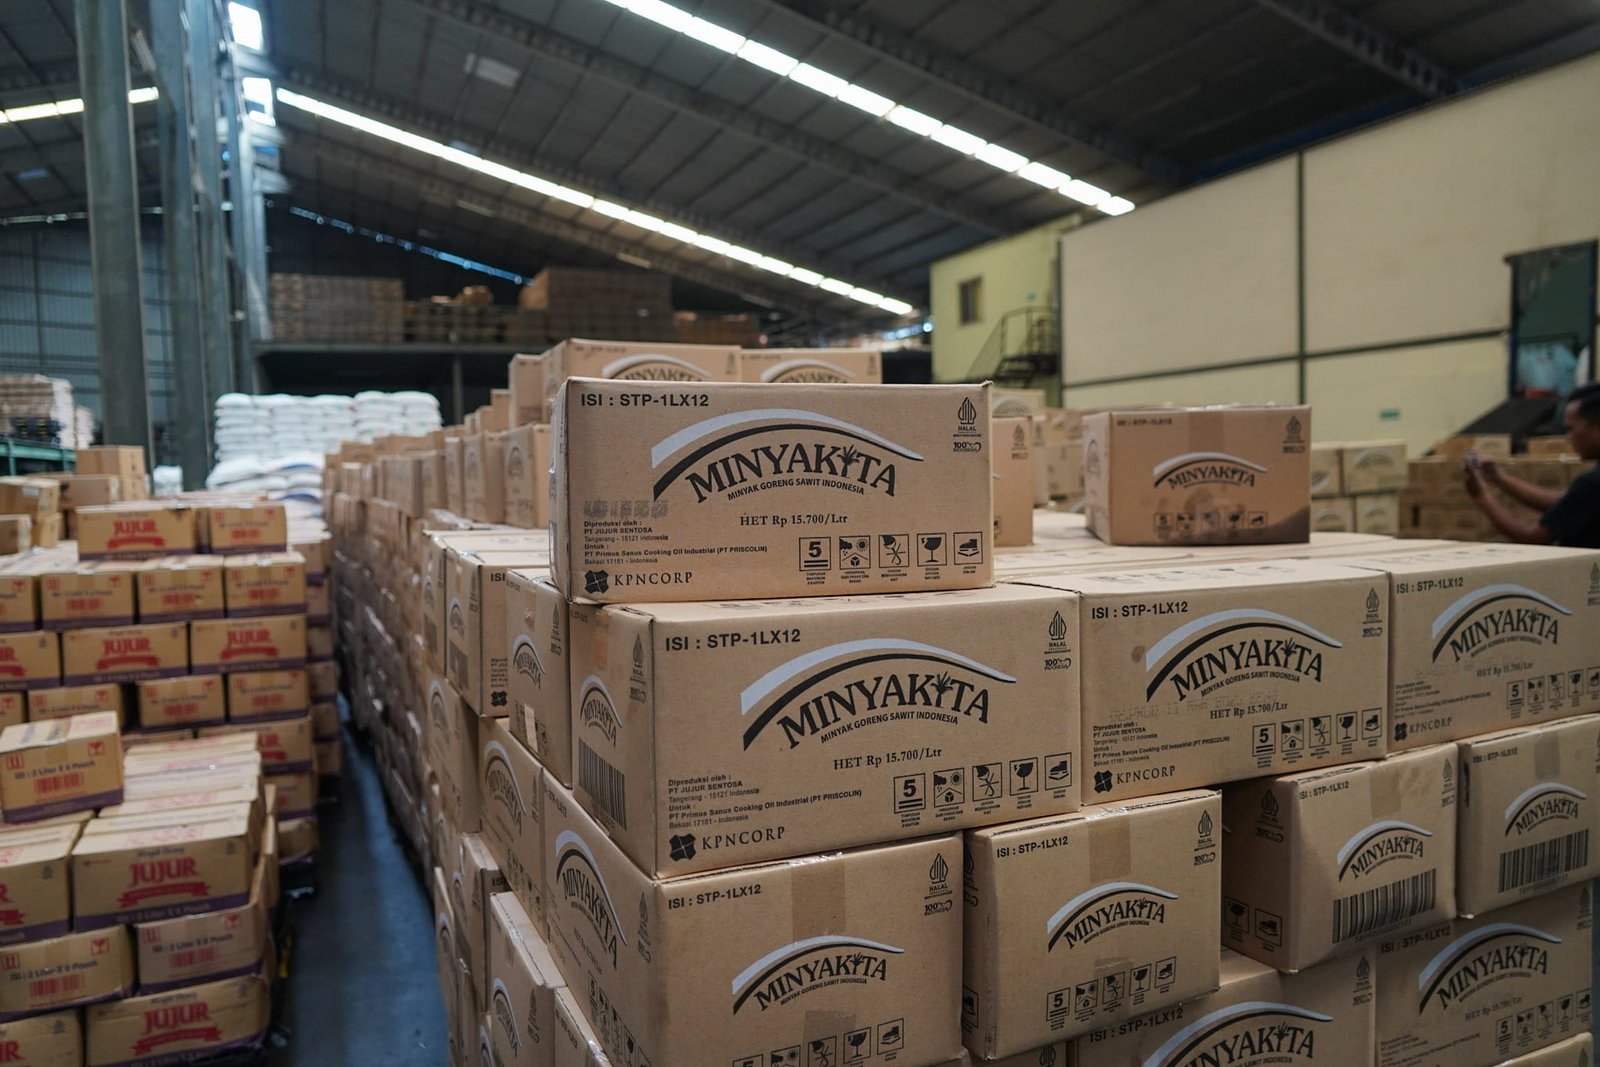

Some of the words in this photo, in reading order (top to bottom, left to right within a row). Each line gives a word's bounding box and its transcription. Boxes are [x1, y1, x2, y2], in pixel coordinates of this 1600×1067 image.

[581, 394, 603, 406] ISI
[620, 394, 709, 406] STP-1LX12
[685, 443, 895, 503] MINYAKITA
[1168, 466, 1256, 489] MINYAKITA
[728, 484, 759, 501] MINYAK
[760, 478, 794, 490] GORENG
[796, 478, 820, 486] SAWIT
[822, 479, 864, 495] INDONESIA
[584, 520, 622, 528] Diproduksi
[740, 516, 768, 526] HET
[772, 515, 788, 528] Rp
[791, 513, 848, 525] 15.700/Ltr
[808, 541, 822, 558] 5
[491, 573, 506, 582] ISI
[614, 572, 692, 586] KPNCORP
[1396, 583, 1409, 594] ISI
[1416, 576, 1464, 592] STP-1LX12
[1092, 607, 1108, 620] ISI
[1122, 601, 1188, 617] STP-1LX12
[666, 636, 688, 651] ISI
[707, 628, 801, 648] STP-1LX12
[1450, 608, 1558, 662] MINYAKITA
[1170, 638, 1322, 701] MINYAKITA
[1201, 681, 1224, 696] MINYAK
[1511, 684, 1519, 697] 5
[776, 671, 989, 750] MINYAKITA
[1210, 709, 1231, 720] HET
[1234, 707, 1245, 718] Rp
[820, 723, 853, 744] MINYAK
[854, 713, 888, 729] GORENG
[890, 711, 914, 721] SAWIT
[916, 711, 958, 725] INDONESIA
[1260, 728, 1269, 743] 5
[833, 758, 862, 770] HET
[866, 755, 882, 768] Rp
[886, 748, 942, 764] 15.700/Ltr
[668, 777, 710, 788] Diproduksi
[711, 774, 726, 782] oleh
[1116, 765, 1176, 784] KPNCORP
[669, 794, 702, 804] Tangerang
[730, 788, 760, 796] Indonesia
[681, 785, 706, 794] JUJUR
[708, 780, 743, 790] SENTOSA
[903, 779, 916, 798] 5
[669, 804, 691, 812] Untuk
[681, 810, 708, 819] Primus
[709, 808, 732, 816] Sanus
[734, 804, 763, 813] Cooking
[764, 801, 775, 809] Oil
[776, 796, 809, 808] Industrial
[810, 794, 821, 804] (PT
[822, 789, 862, 801] PRISCOLIN)
[669, 822, 691, 830] Bekasi
[718, 814, 748, 824] Indonesia
[1516, 798, 1578, 836] MINYAKITA
[702, 826, 785, 850] KPNCORP
[997, 847, 1010, 858] ISI
[1018, 836, 1068, 854] STP-1LX12
[1350, 836, 1424, 879] MINYAKITA
[130, 858, 198, 887] JUJUR
[668, 897, 684, 910] ISI
[696, 884, 761, 904] STP-1LX12
[1064, 896, 1165, 950] MINYAKITA
[754, 952, 886, 1011] MINYAKITA
[1436, 943, 1548, 1010] MINYAKITA
[1054, 992, 1064, 1008] 5
[144, 1002, 212, 1030] JUJUR
[1090, 1030, 1106, 1043] ISI
[1119, 1008, 1184, 1036] STP-1LX12
